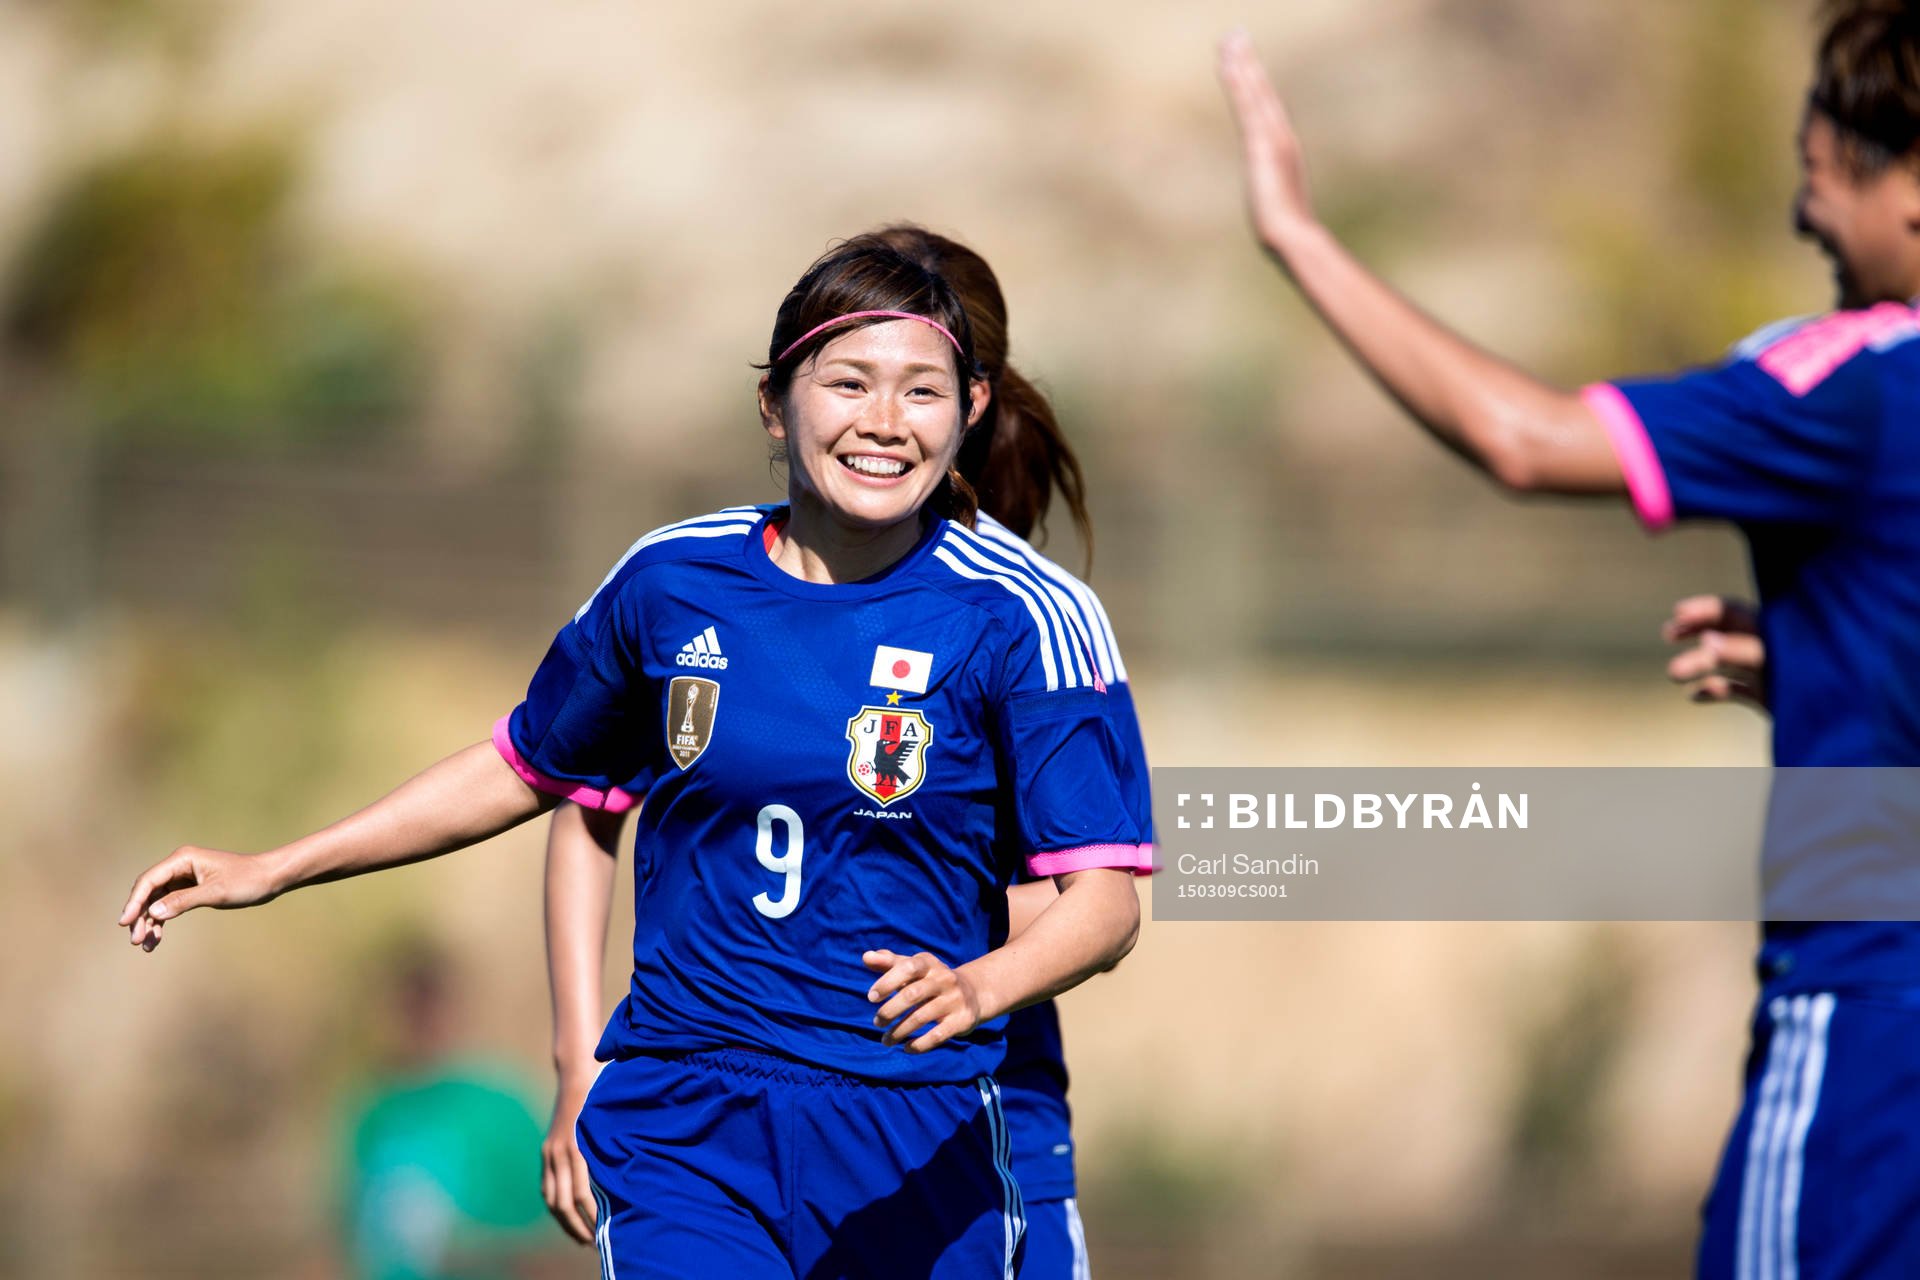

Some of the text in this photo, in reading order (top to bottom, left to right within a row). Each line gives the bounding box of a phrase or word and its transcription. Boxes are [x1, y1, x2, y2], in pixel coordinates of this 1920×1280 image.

[676, 651, 728, 670] adidas
[676, 734, 696, 746] FIFA
[853, 808, 912, 819] JAPAN
[752, 804, 804, 919] 9
